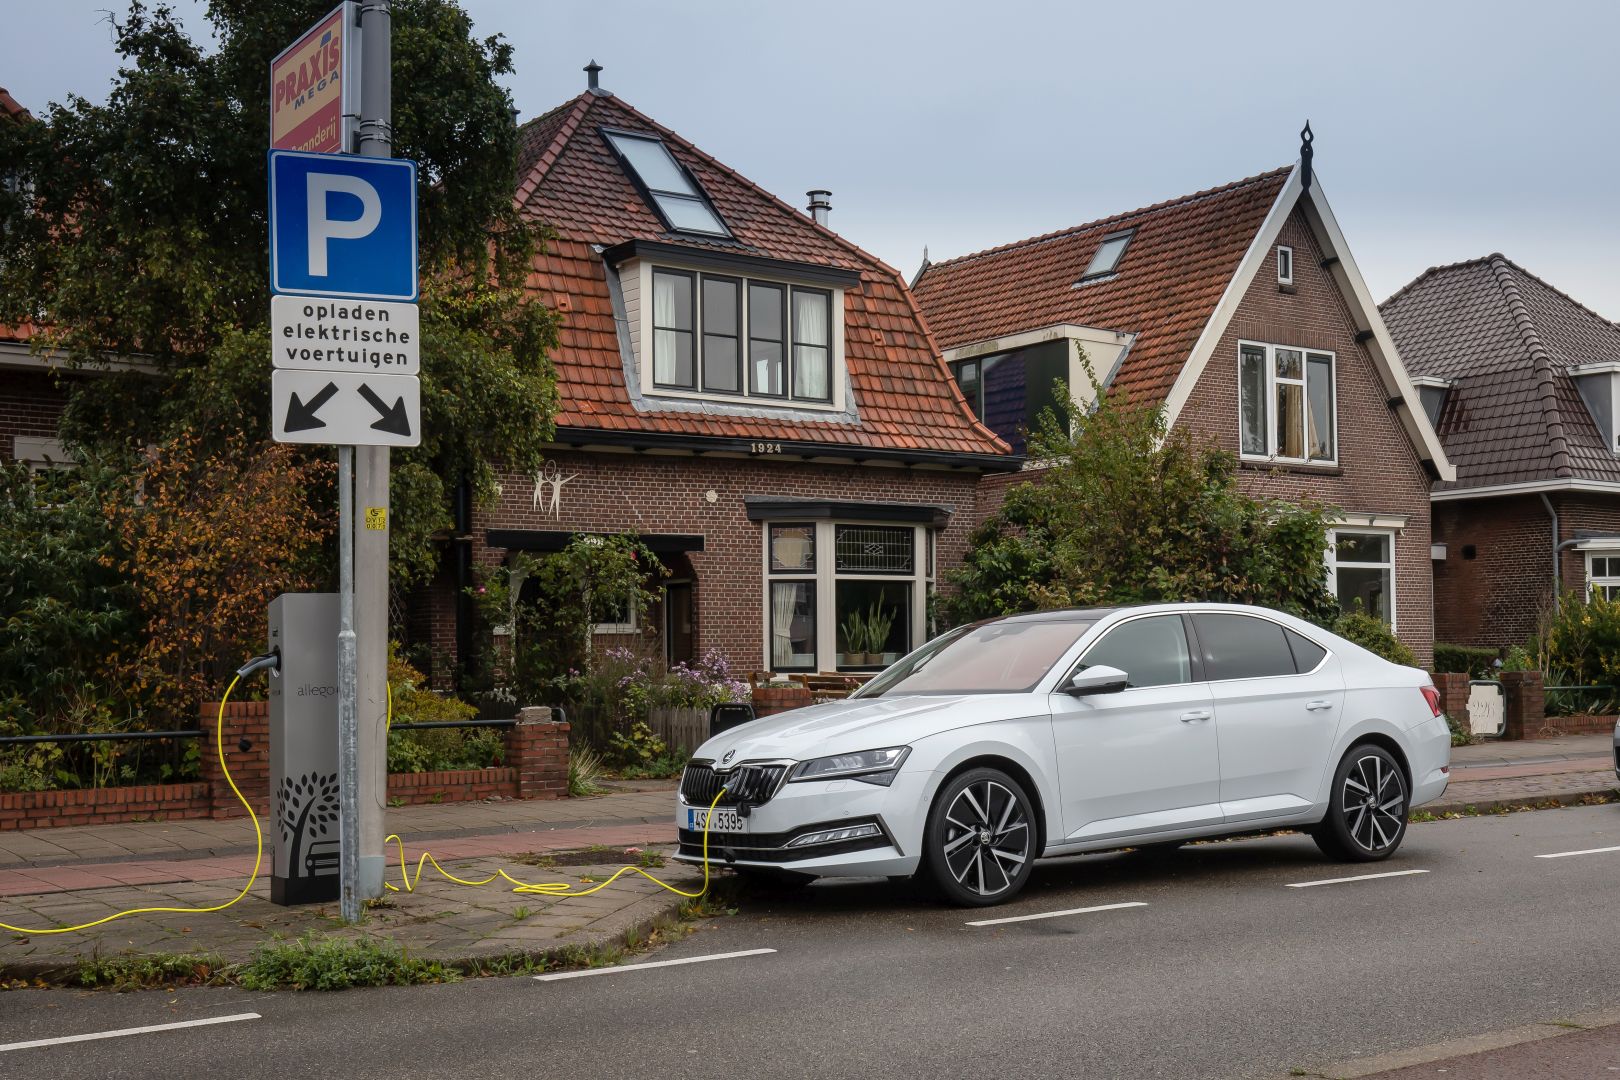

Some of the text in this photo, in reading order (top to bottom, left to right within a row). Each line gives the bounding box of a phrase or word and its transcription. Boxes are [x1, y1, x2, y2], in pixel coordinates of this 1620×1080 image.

[275, 31, 340, 113] PRAXIS
[294, 70, 339, 110] MEGA
[306, 171, 382, 277] P
[303, 304, 389, 322] opladen
[283, 324, 410, 344] elektrische
[286, 347, 408, 369] voertuigen
[751, 442, 781, 454] 1924
[297, 682, 335, 698] allego
[718, 812, 743, 831] 5395
